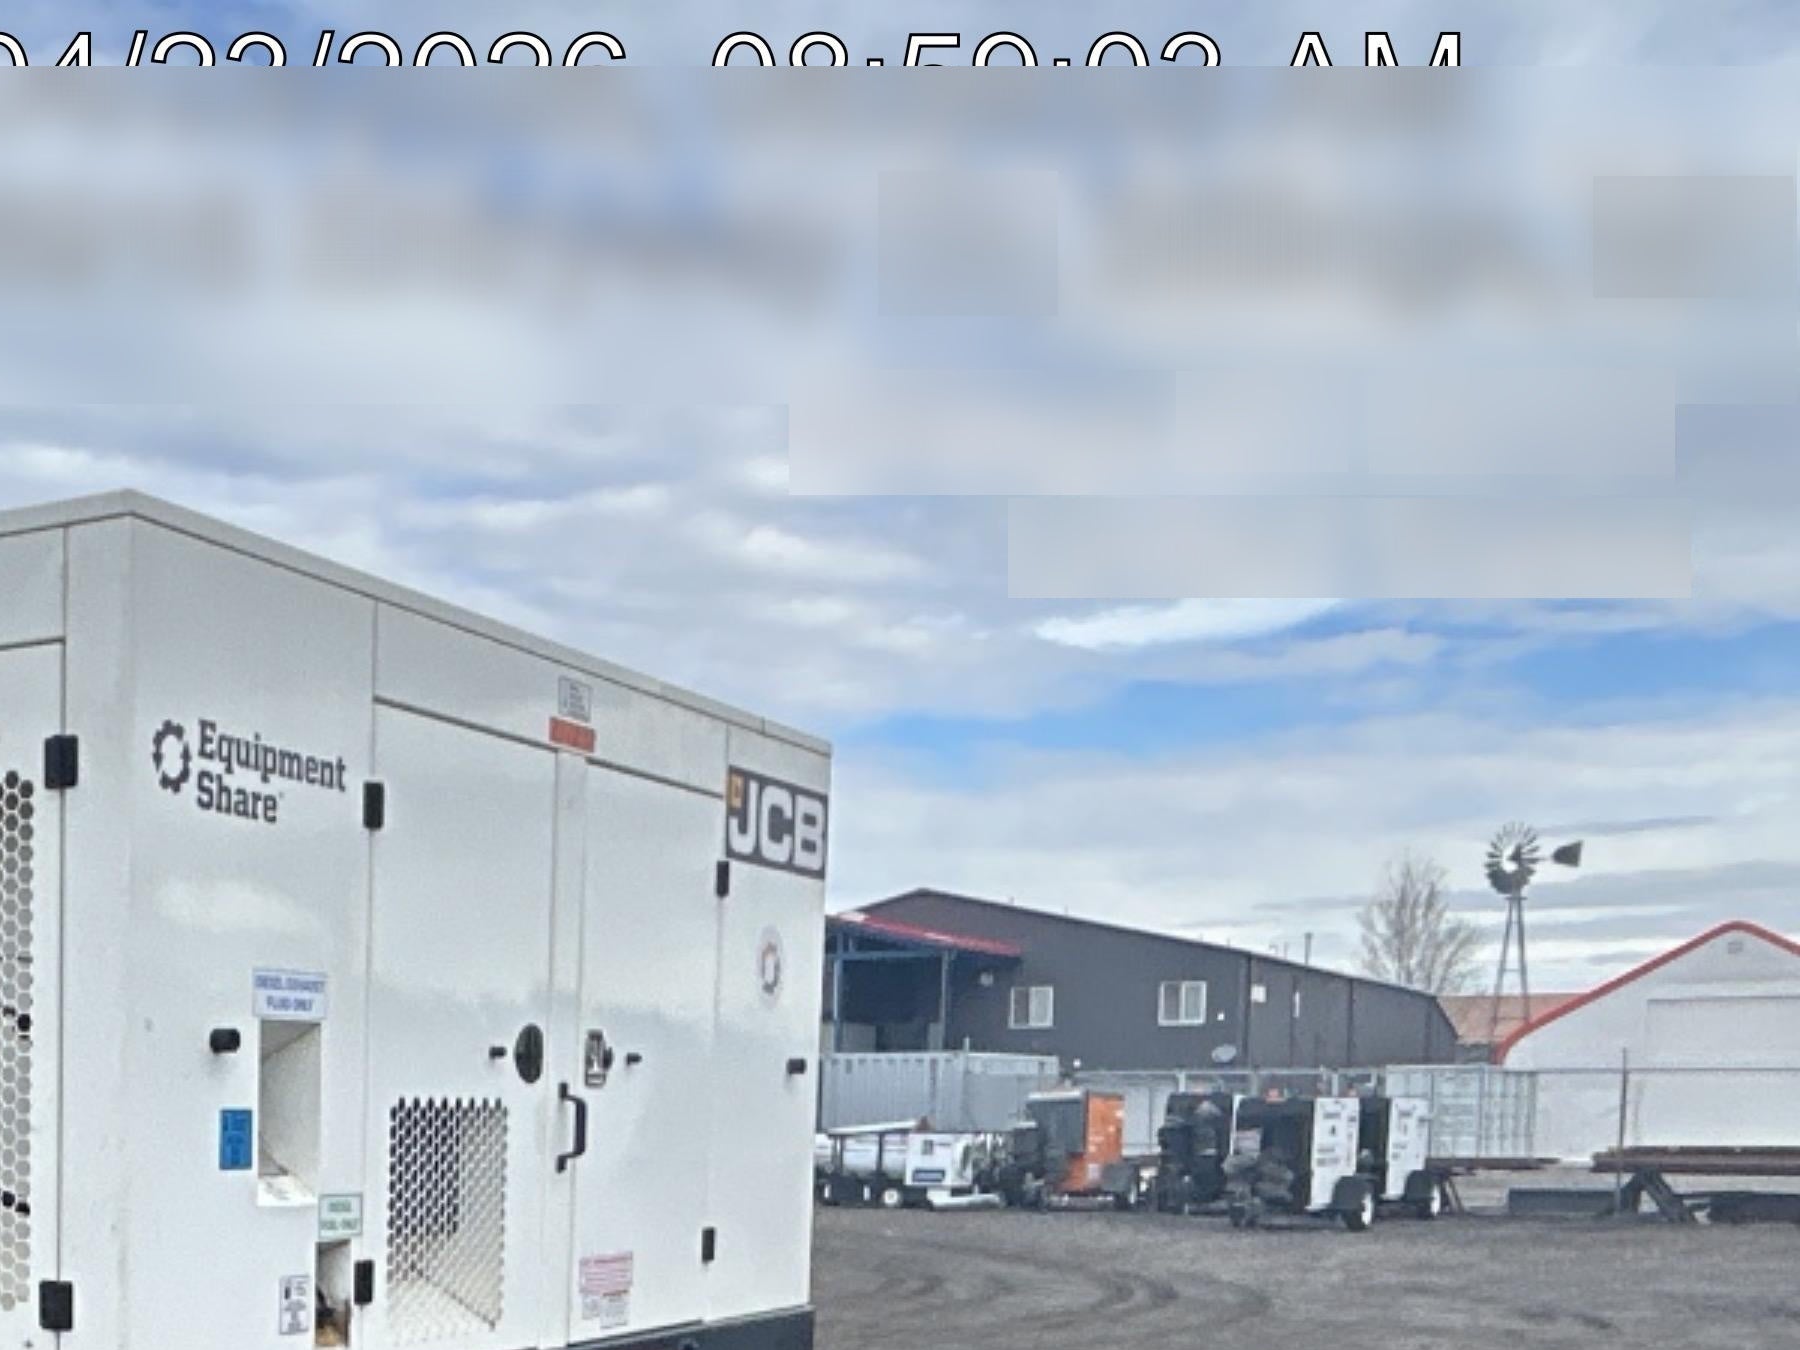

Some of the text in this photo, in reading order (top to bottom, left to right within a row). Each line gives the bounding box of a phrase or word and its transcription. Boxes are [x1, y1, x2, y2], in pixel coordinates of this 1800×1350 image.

[198, 718, 346, 792] Equipment
[197, 770, 278, 824] Share
[728, 780, 825, 872] JCB
